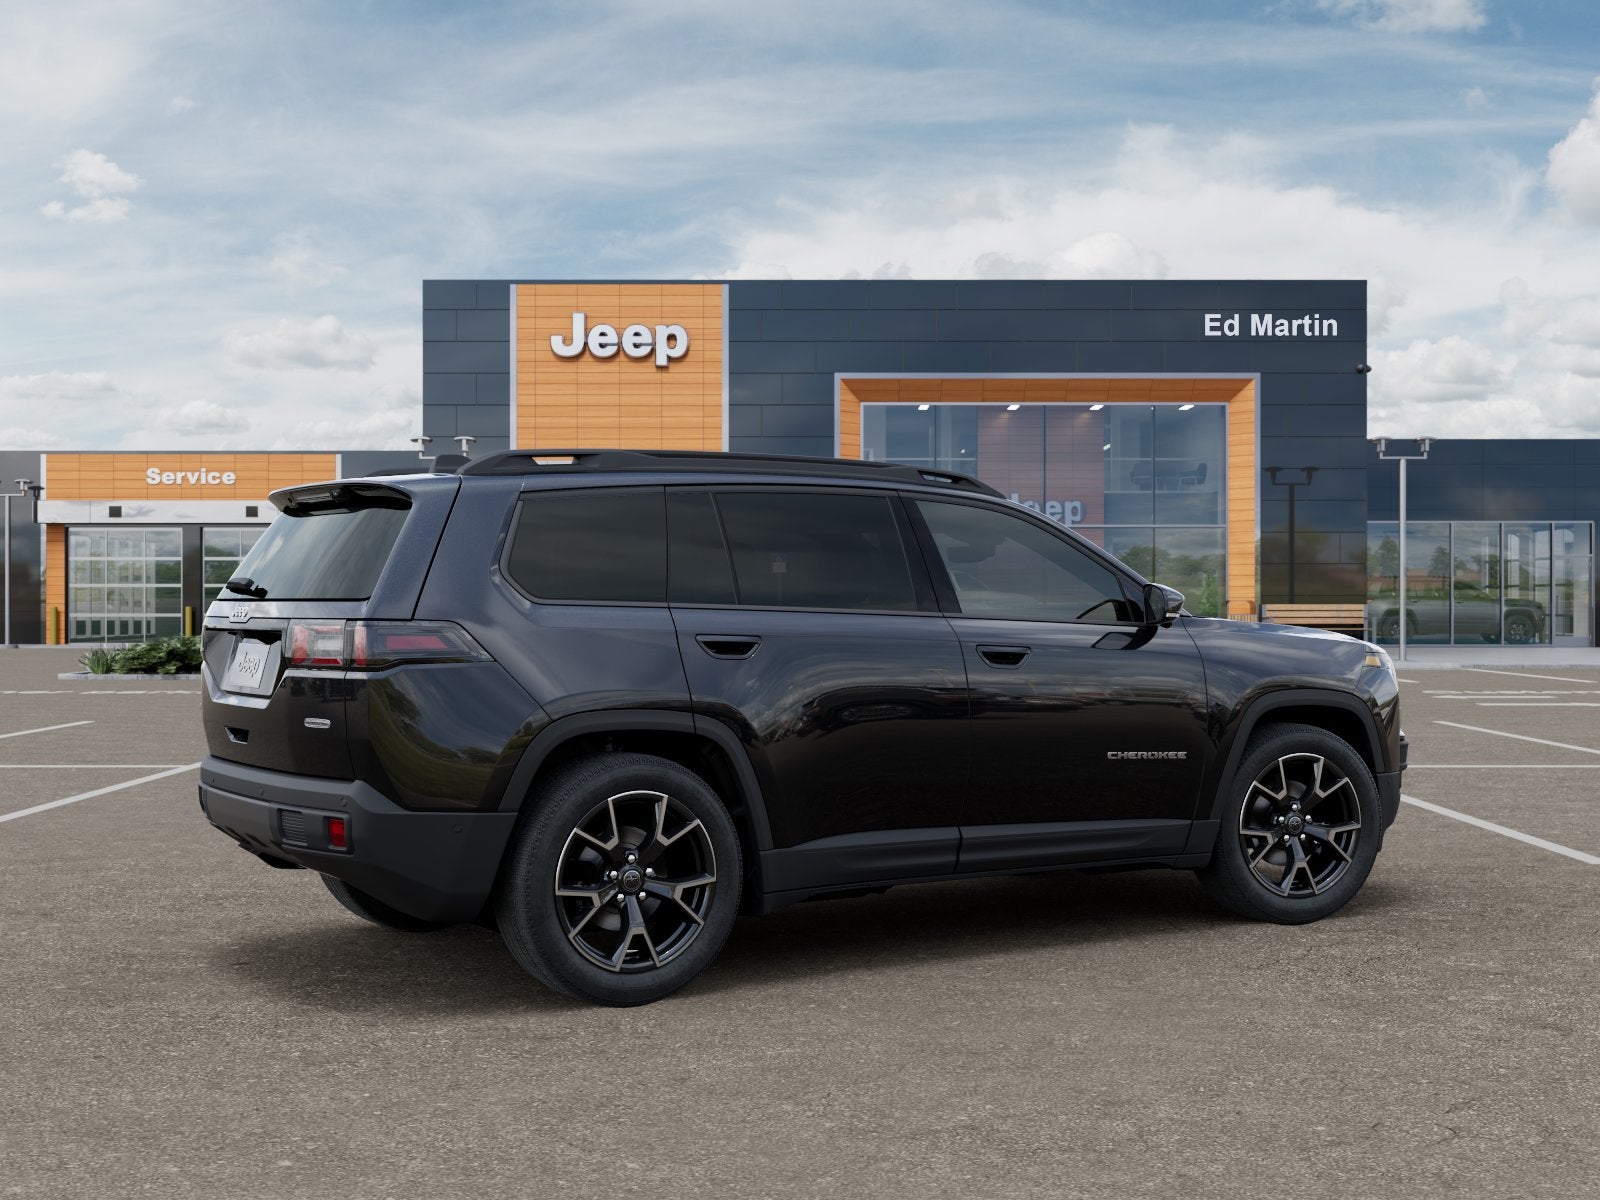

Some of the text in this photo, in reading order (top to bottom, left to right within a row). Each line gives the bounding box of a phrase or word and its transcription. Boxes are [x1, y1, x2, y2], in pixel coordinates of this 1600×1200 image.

[1204, 313, 1338, 336] Ed Martin
[550, 312, 689, 367] Jeep
[146, 467, 236, 485] Service
[1010, 493, 1084, 527] ep
[1107, 751, 1187, 760] CHEROKEE
